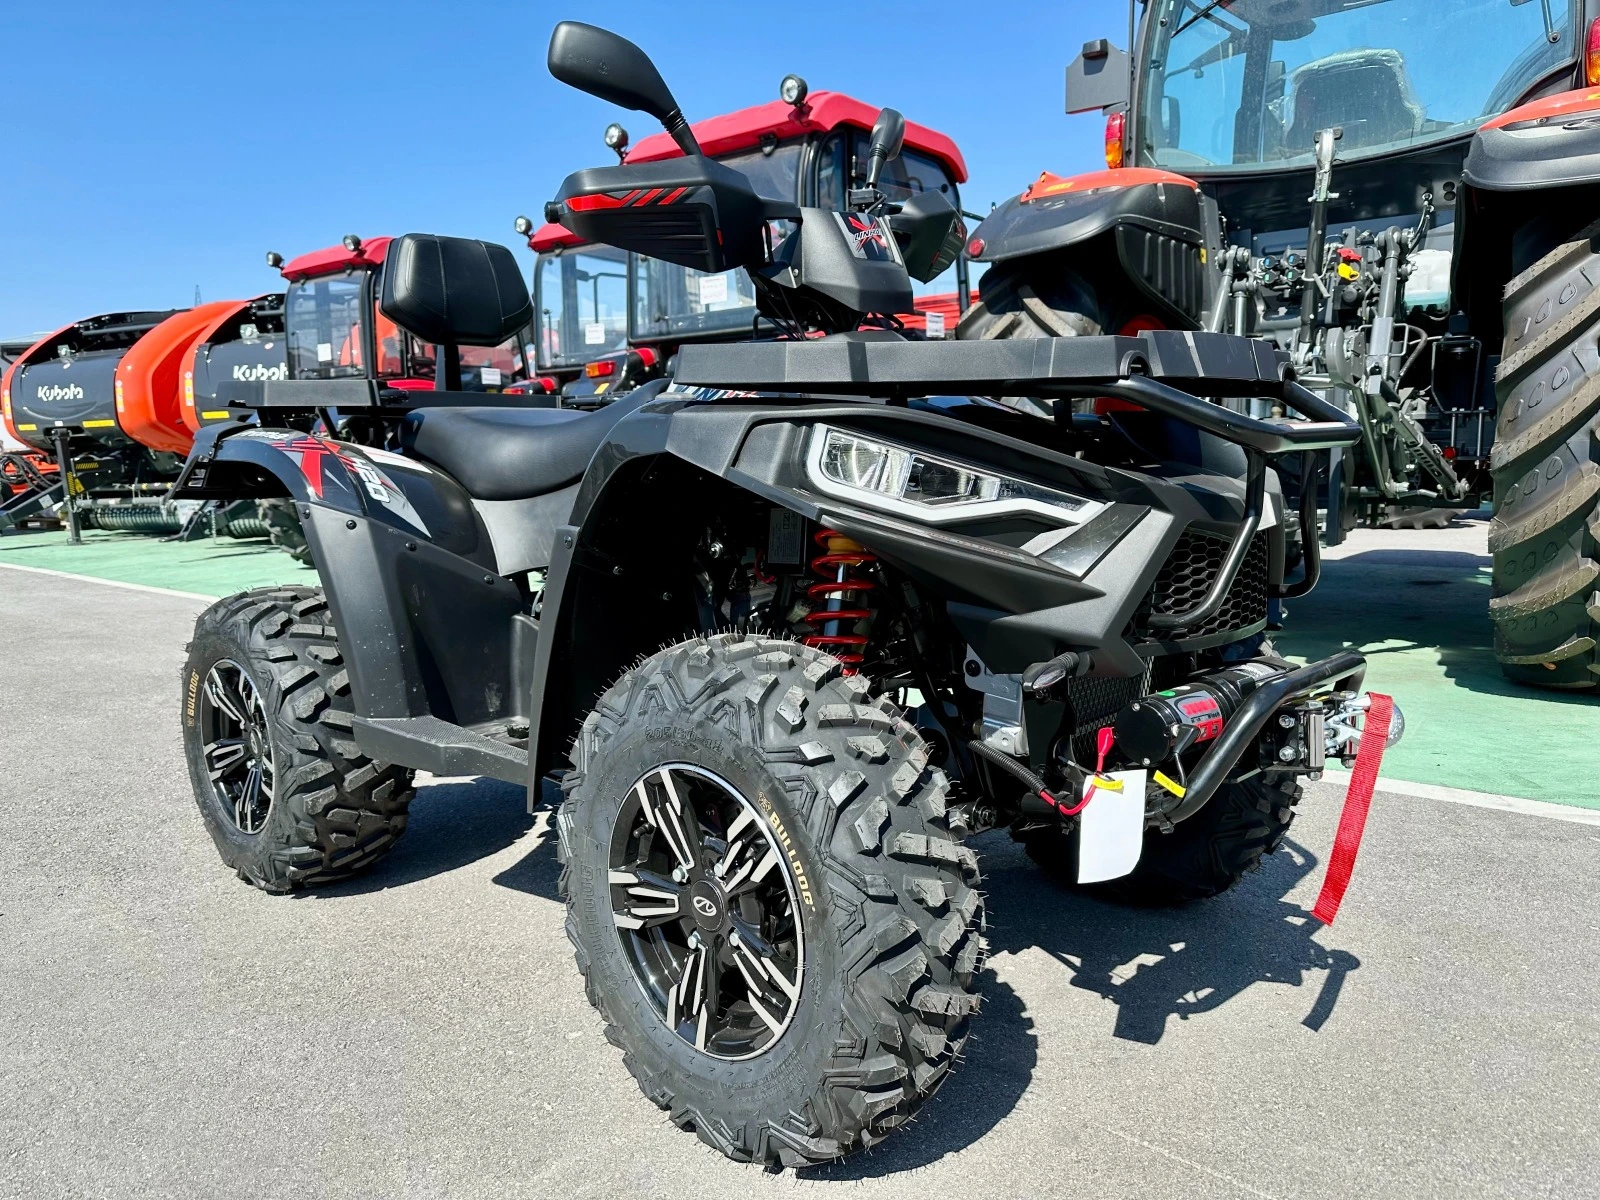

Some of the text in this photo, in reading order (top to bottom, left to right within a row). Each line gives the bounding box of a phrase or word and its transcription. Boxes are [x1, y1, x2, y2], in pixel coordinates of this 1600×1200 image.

[37, 383, 84, 402] Kubota
[187, 671, 199, 717] BULLDOG
[769, 811, 814, 905] BULLDOG
